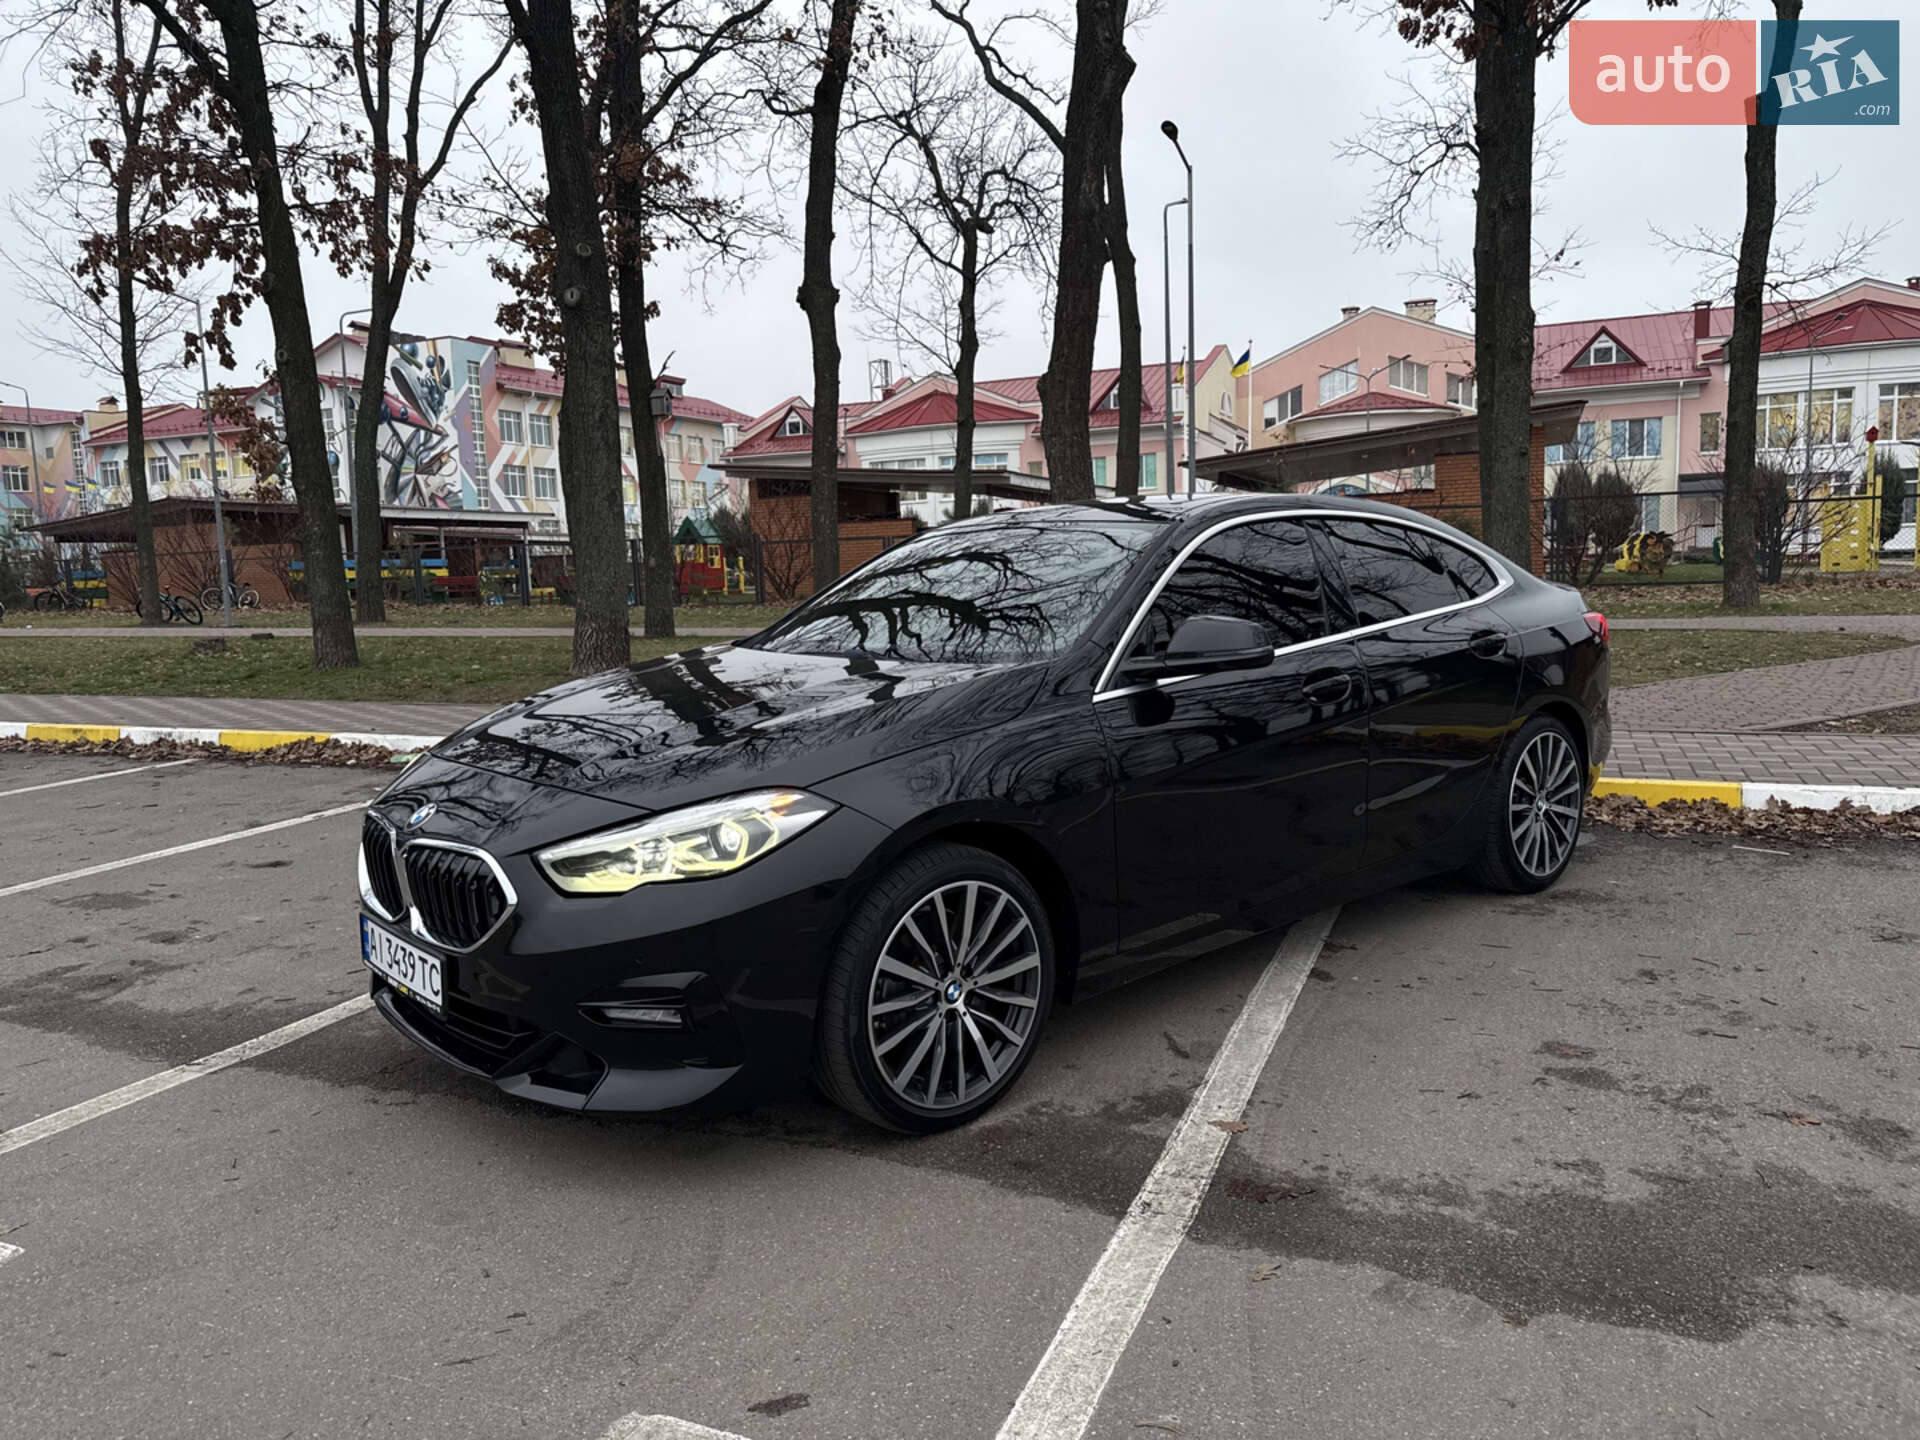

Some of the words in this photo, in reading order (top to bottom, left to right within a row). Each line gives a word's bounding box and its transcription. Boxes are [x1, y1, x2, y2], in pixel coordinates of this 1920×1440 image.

[370, 927, 383, 963] AI
[386, 937, 416, 983] 3439
[418, 955, 441, 997] TC
